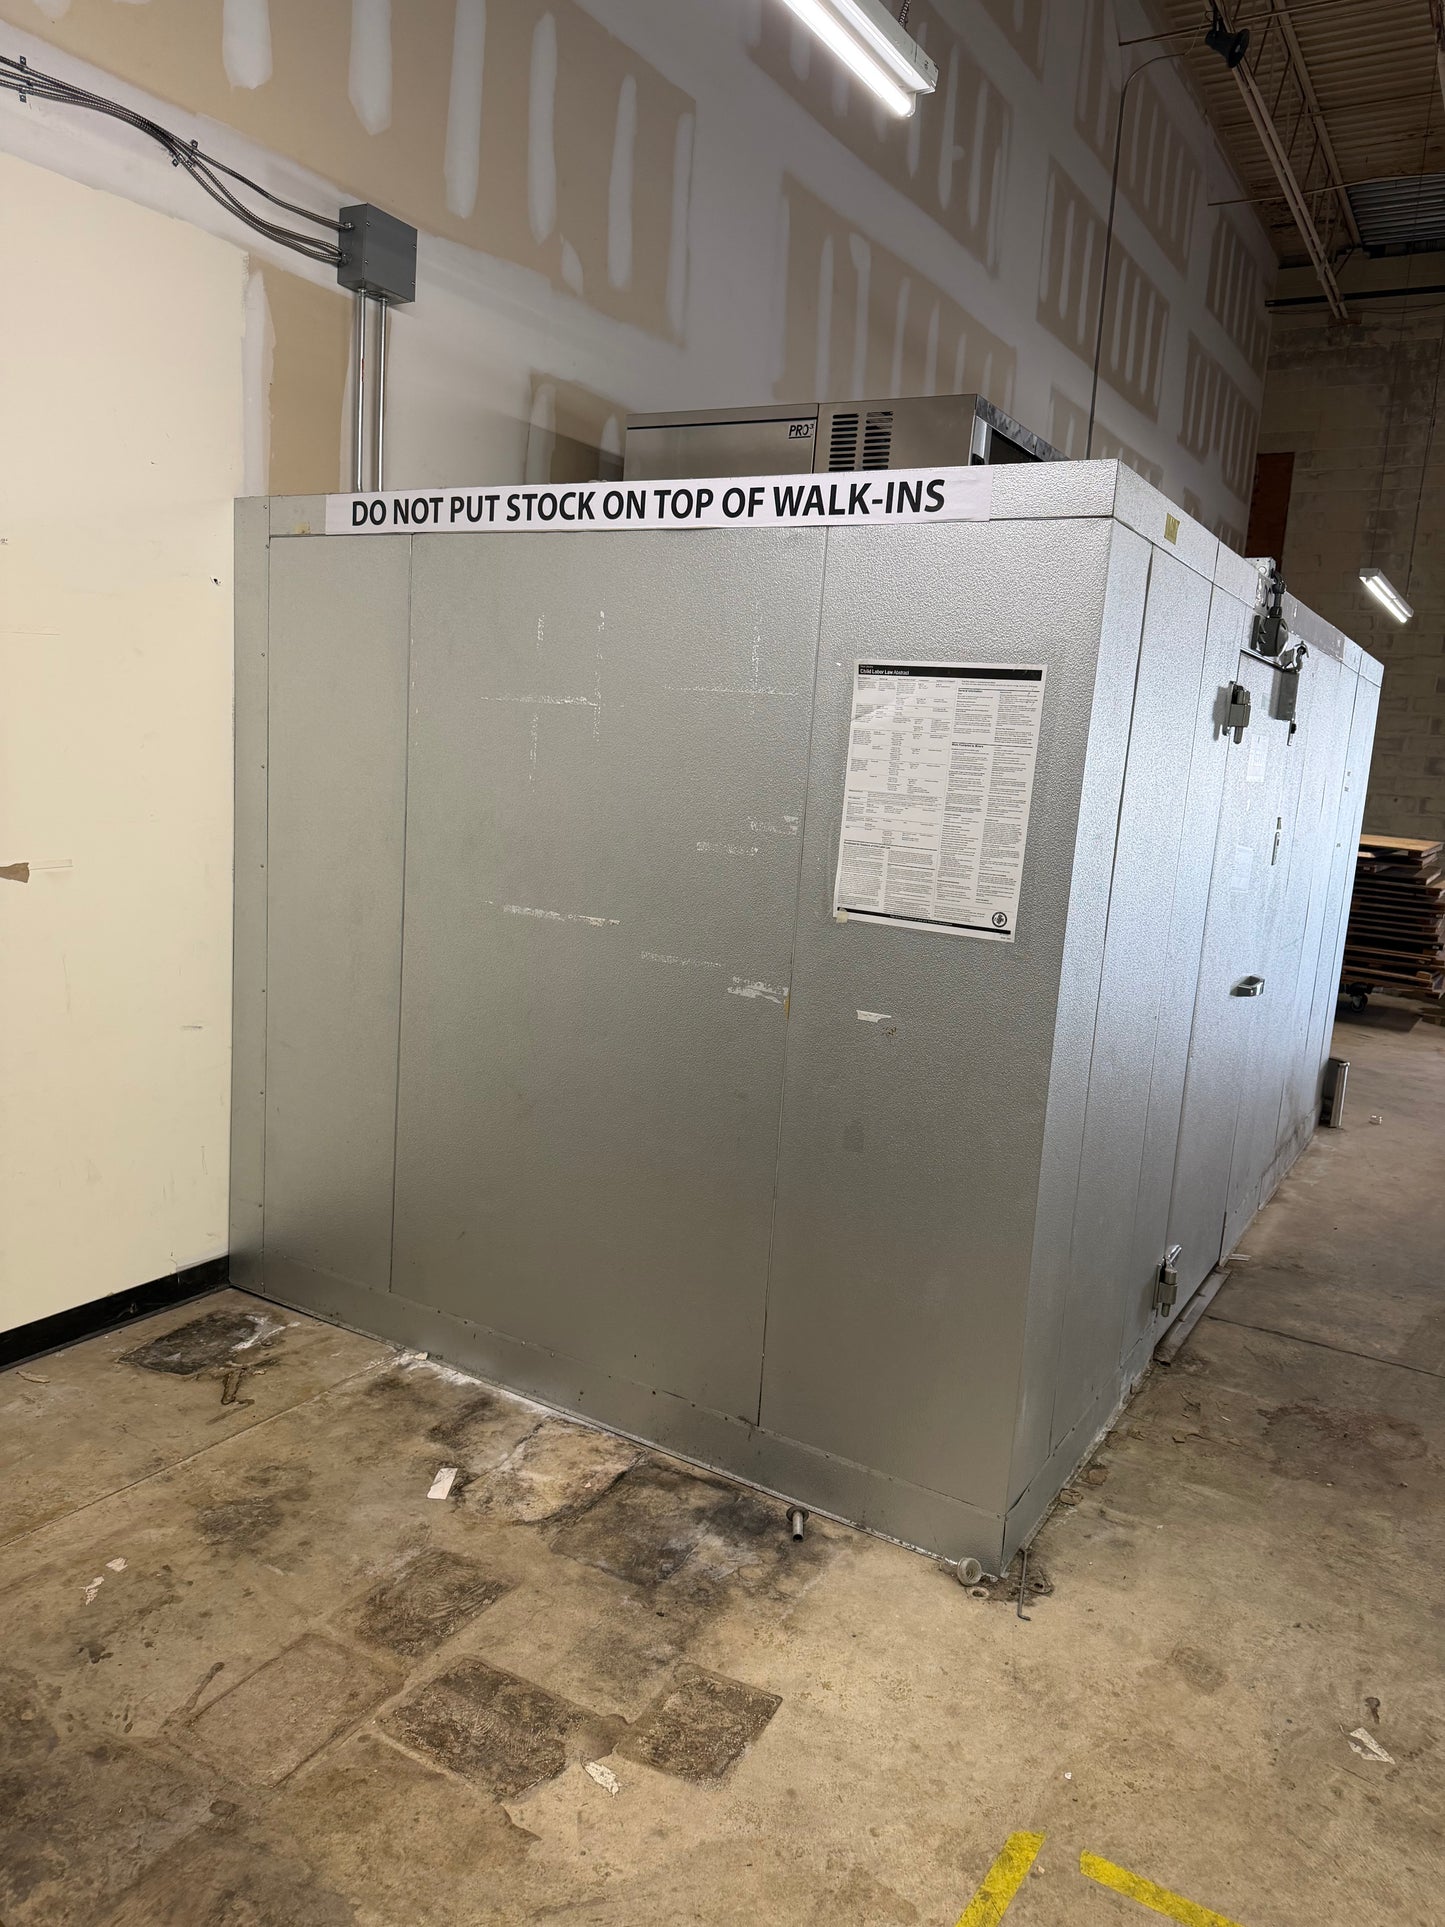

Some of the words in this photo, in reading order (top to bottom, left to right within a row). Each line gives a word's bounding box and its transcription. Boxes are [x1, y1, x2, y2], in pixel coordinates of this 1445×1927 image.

[352, 499, 388, 527] DO
[393, 496, 444, 525] NOT
[450, 494, 501, 523] PUT
[507, 490, 596, 521] STOCK
[602, 489, 647, 520] ON
[653, 488, 715, 519] TOP
[722, 486, 767, 518] OF
[773, 478, 946, 517] WALK-INS
